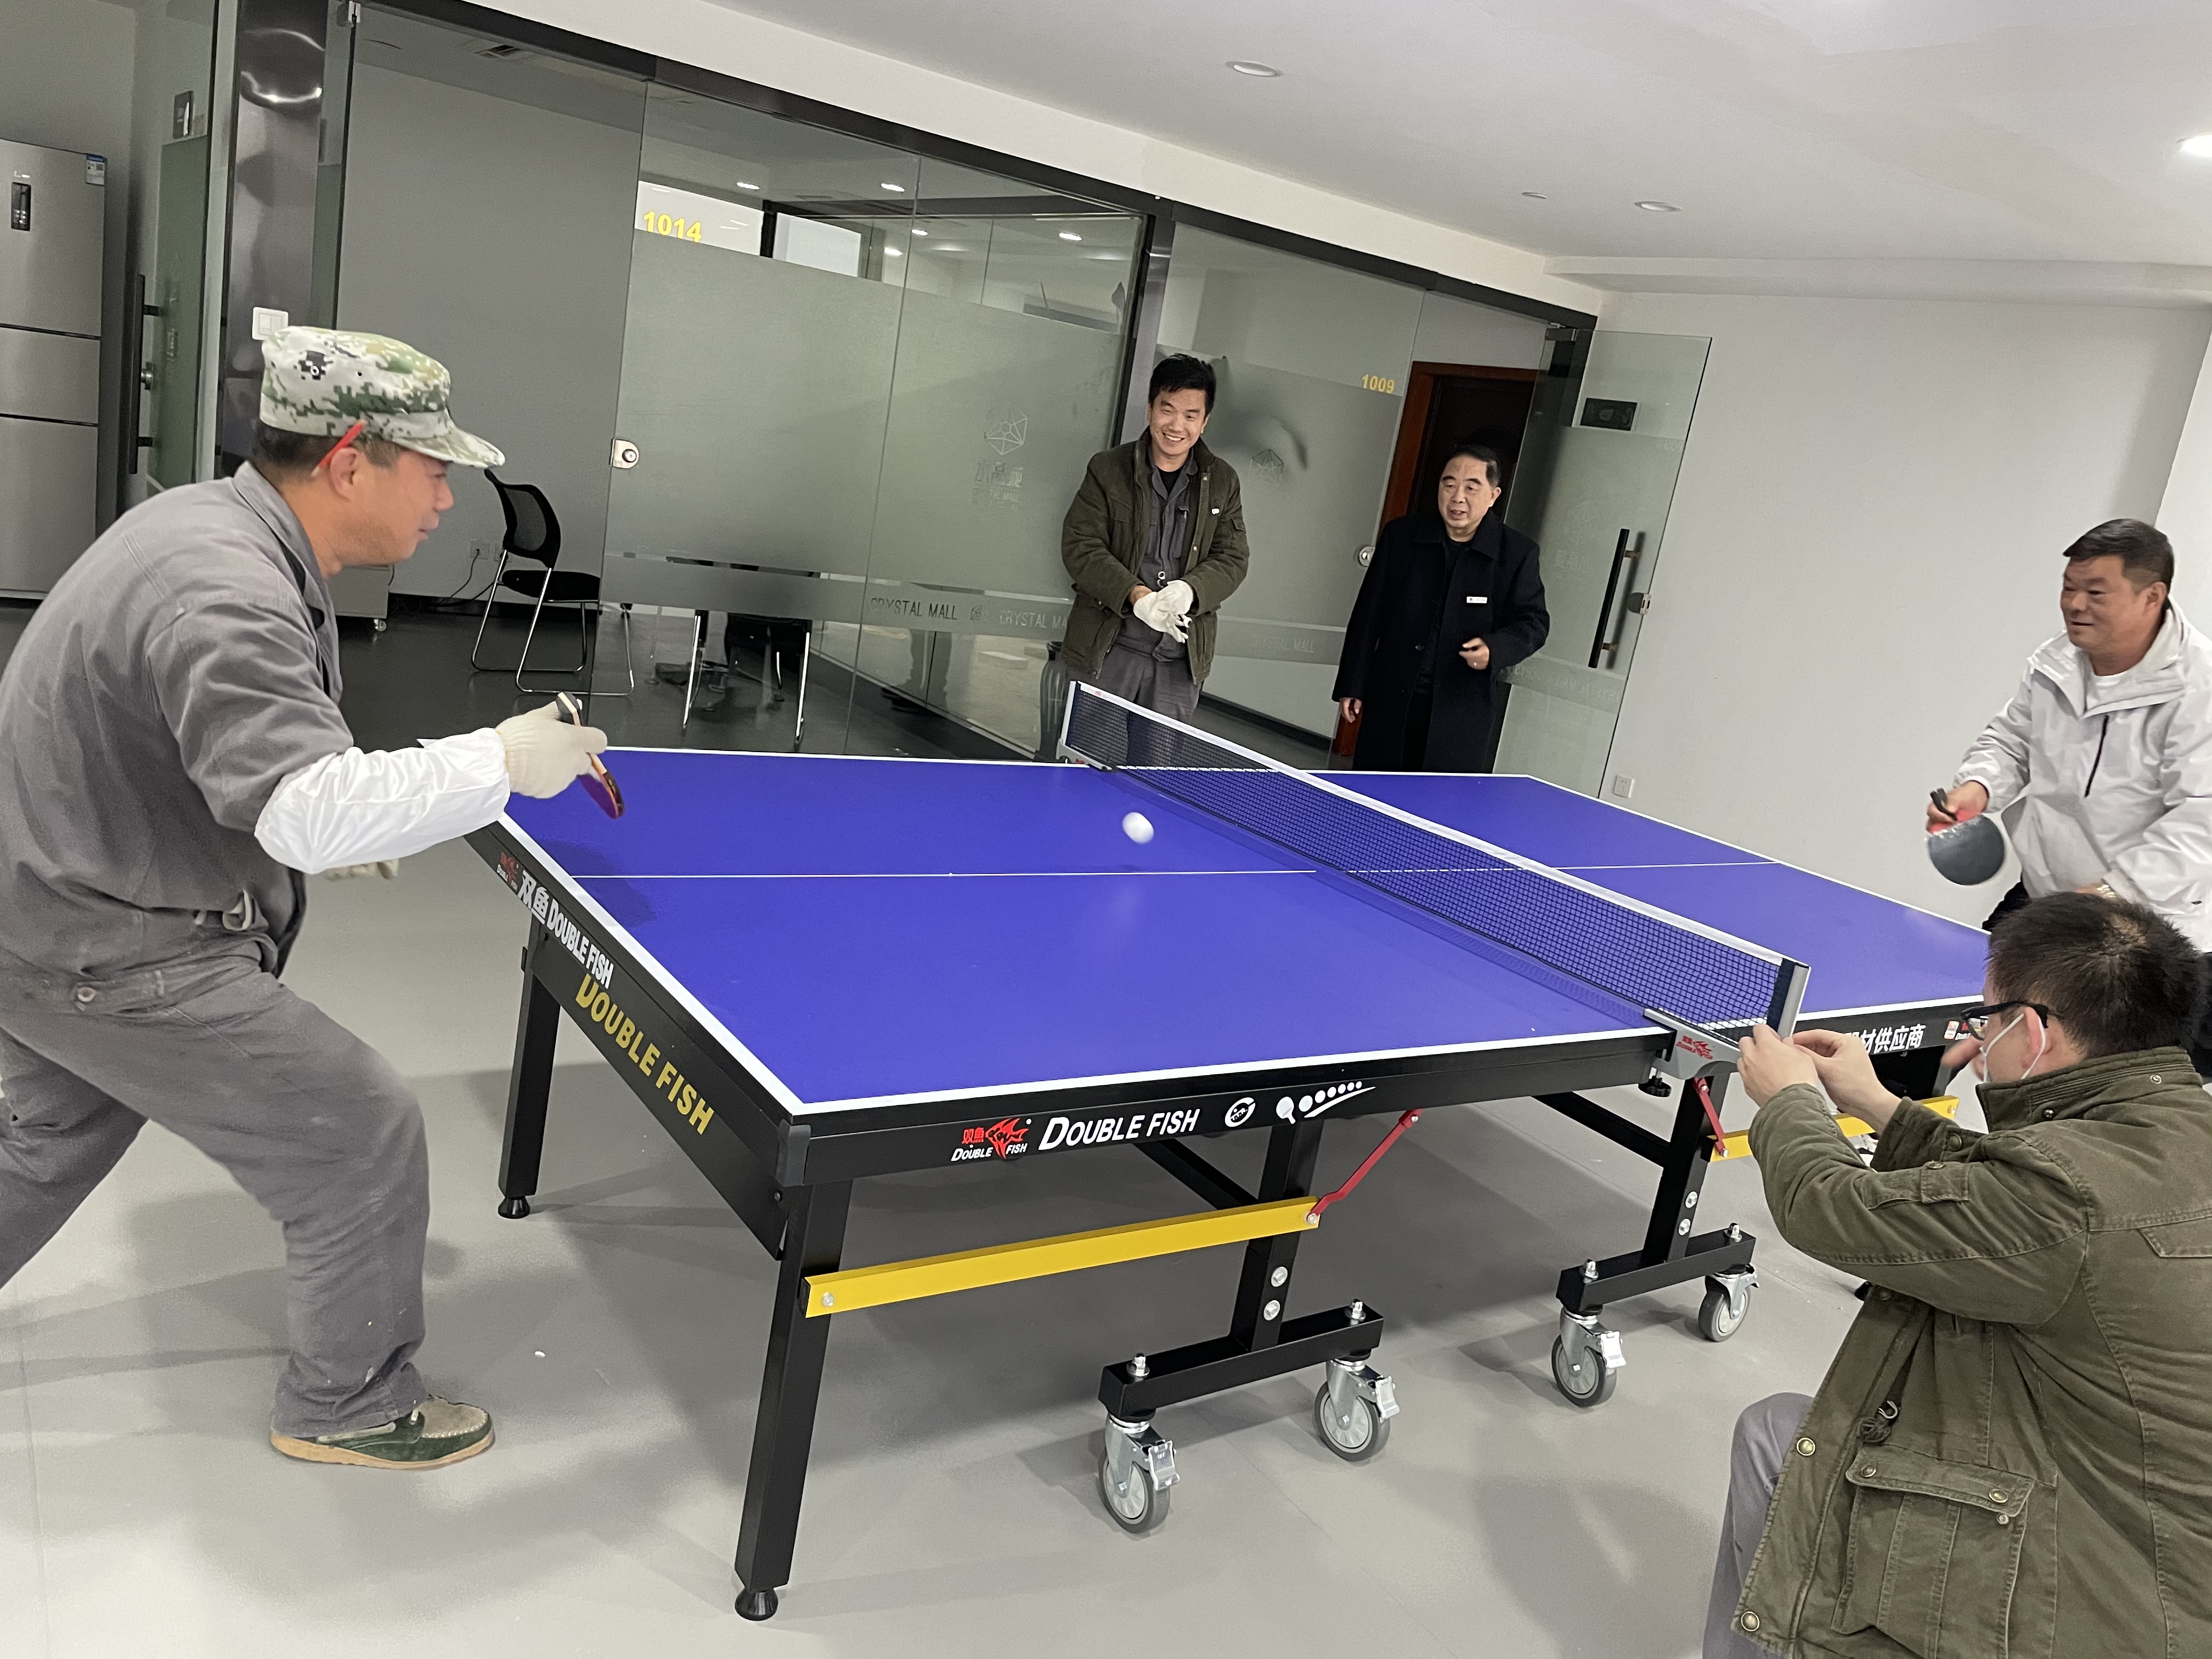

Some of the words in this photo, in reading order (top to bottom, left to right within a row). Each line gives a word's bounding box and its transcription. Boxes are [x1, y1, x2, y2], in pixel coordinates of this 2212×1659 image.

[644, 211, 702, 243] 1014
[1362, 374, 1395, 394] 1009
[871, 597, 923, 617] CRYSTAL
[928, 603, 957, 620] MALL
[999, 610, 1047, 628] CRYSTAL
[1052, 616, 1067, 630] MA
[517, 870, 549, 925] 双鱼
[547, 898, 590, 964] DOUBLE
[585, 944, 614, 989] FISH
[575, 973, 661, 1076] DOUBLE
[655, 1060, 714, 1135] FISH
[1845, 1023, 1926, 1054] 材供应商
[1038, 1116, 1146, 1150] DOUBLE
[1146, 1108, 1200, 1137] FISH
[951, 1147, 994, 1161] DOUBLE
[1005, 1143, 1028, 1154] FISH
